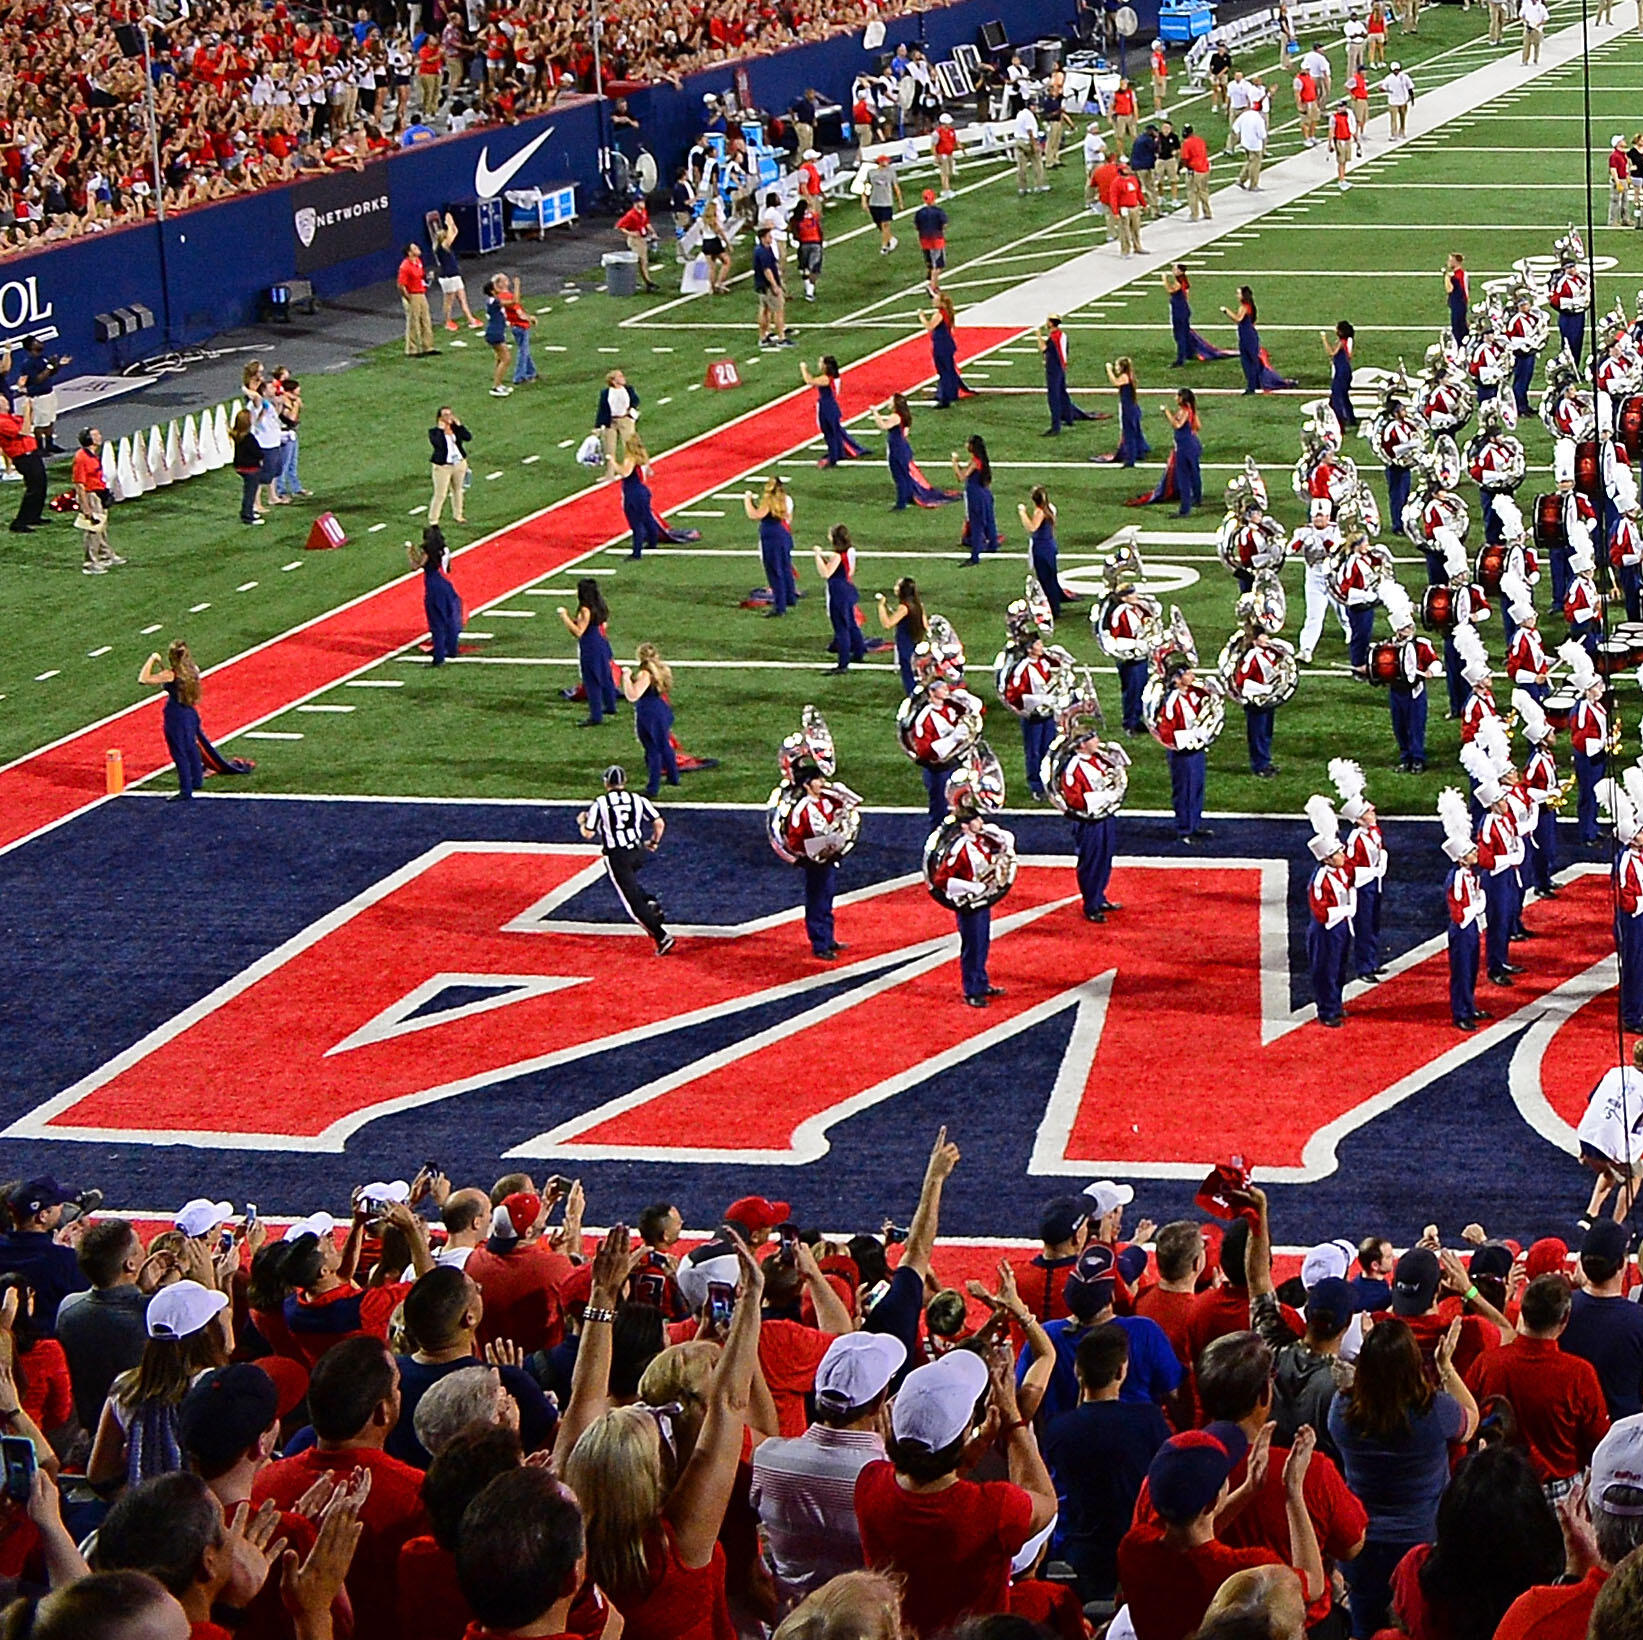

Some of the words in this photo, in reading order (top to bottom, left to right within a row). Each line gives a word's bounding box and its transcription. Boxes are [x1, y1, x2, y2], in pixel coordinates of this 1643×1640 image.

[317, 195, 389, 227] NETWORKS
[715, 364, 738, 385] 20
[324, 516, 346, 544] 10
[613, 804, 632, 829] F
